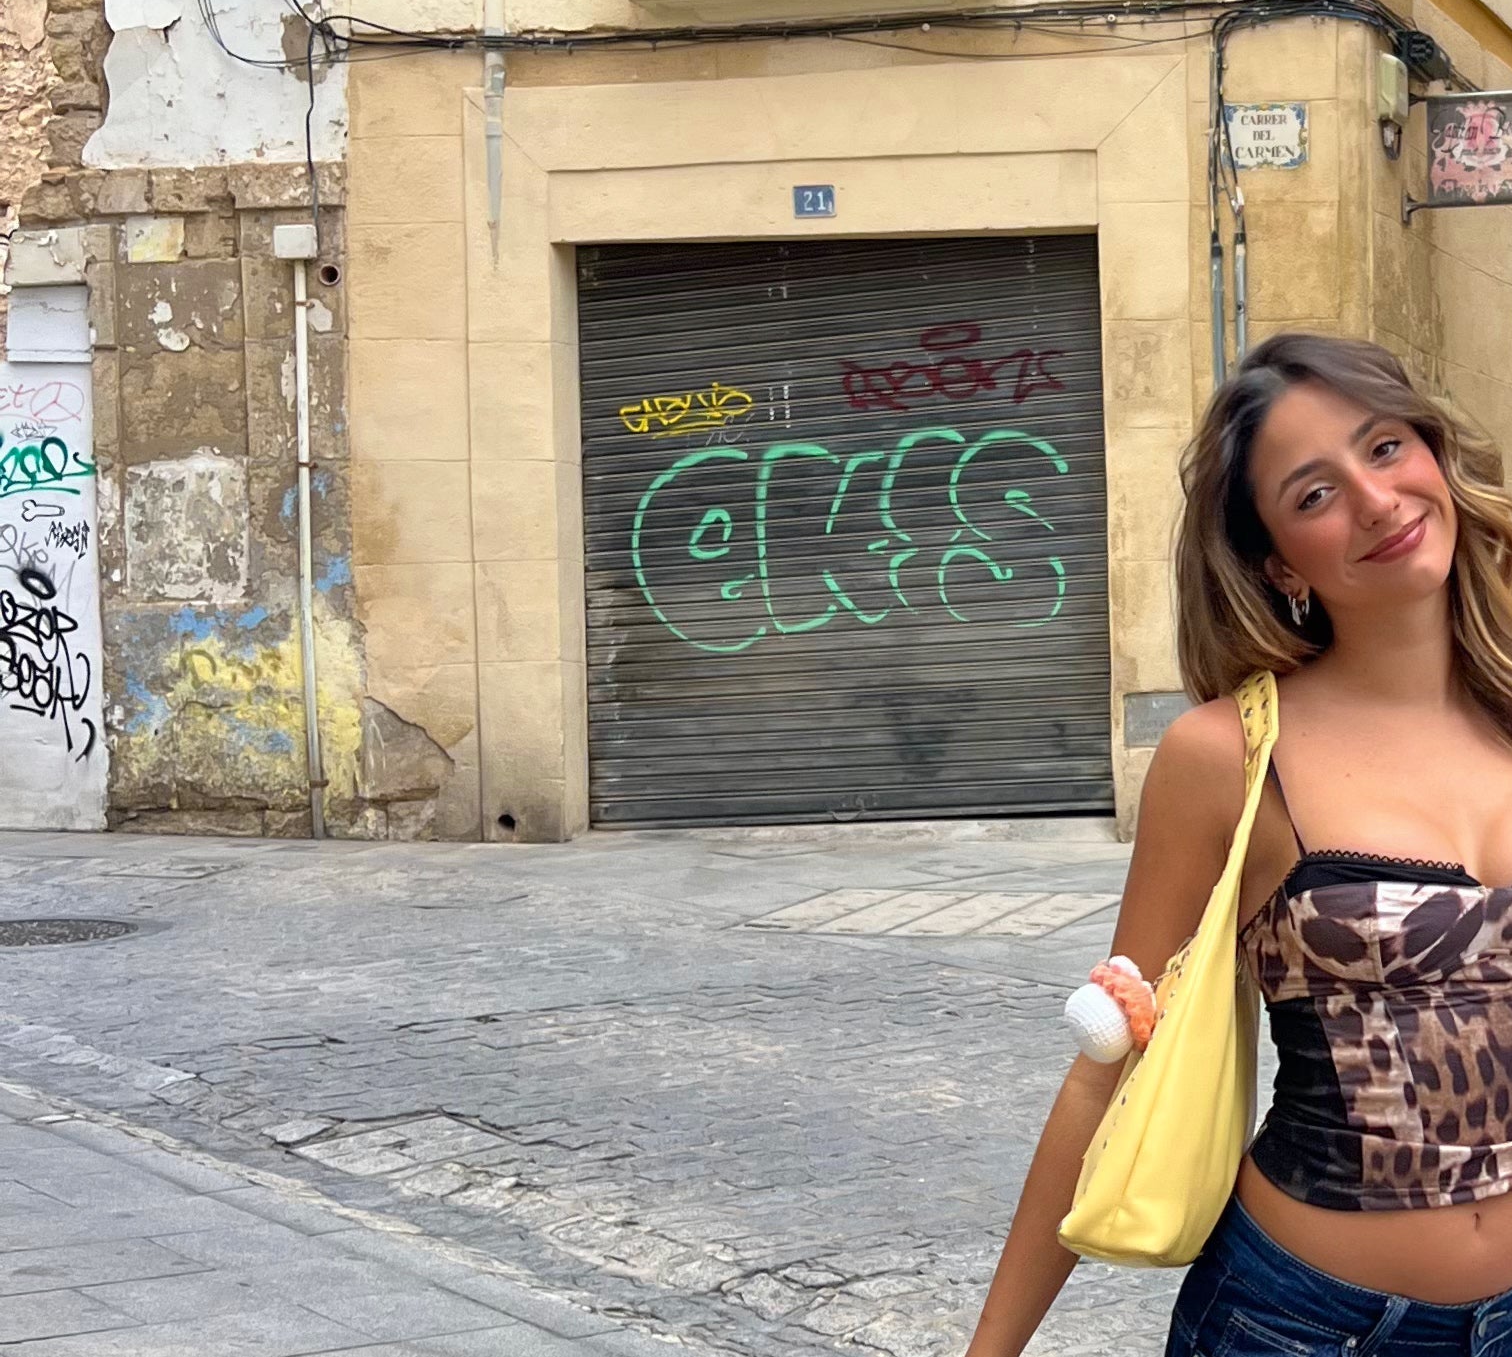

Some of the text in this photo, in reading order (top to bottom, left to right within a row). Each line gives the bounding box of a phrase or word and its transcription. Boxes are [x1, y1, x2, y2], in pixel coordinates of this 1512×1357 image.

[1240, 114, 1288, 126] CARRER
[1252, 130, 1276, 141] DEL
[1235, 146, 1295, 159] CARMEN
[803, 190, 827, 211] 21
